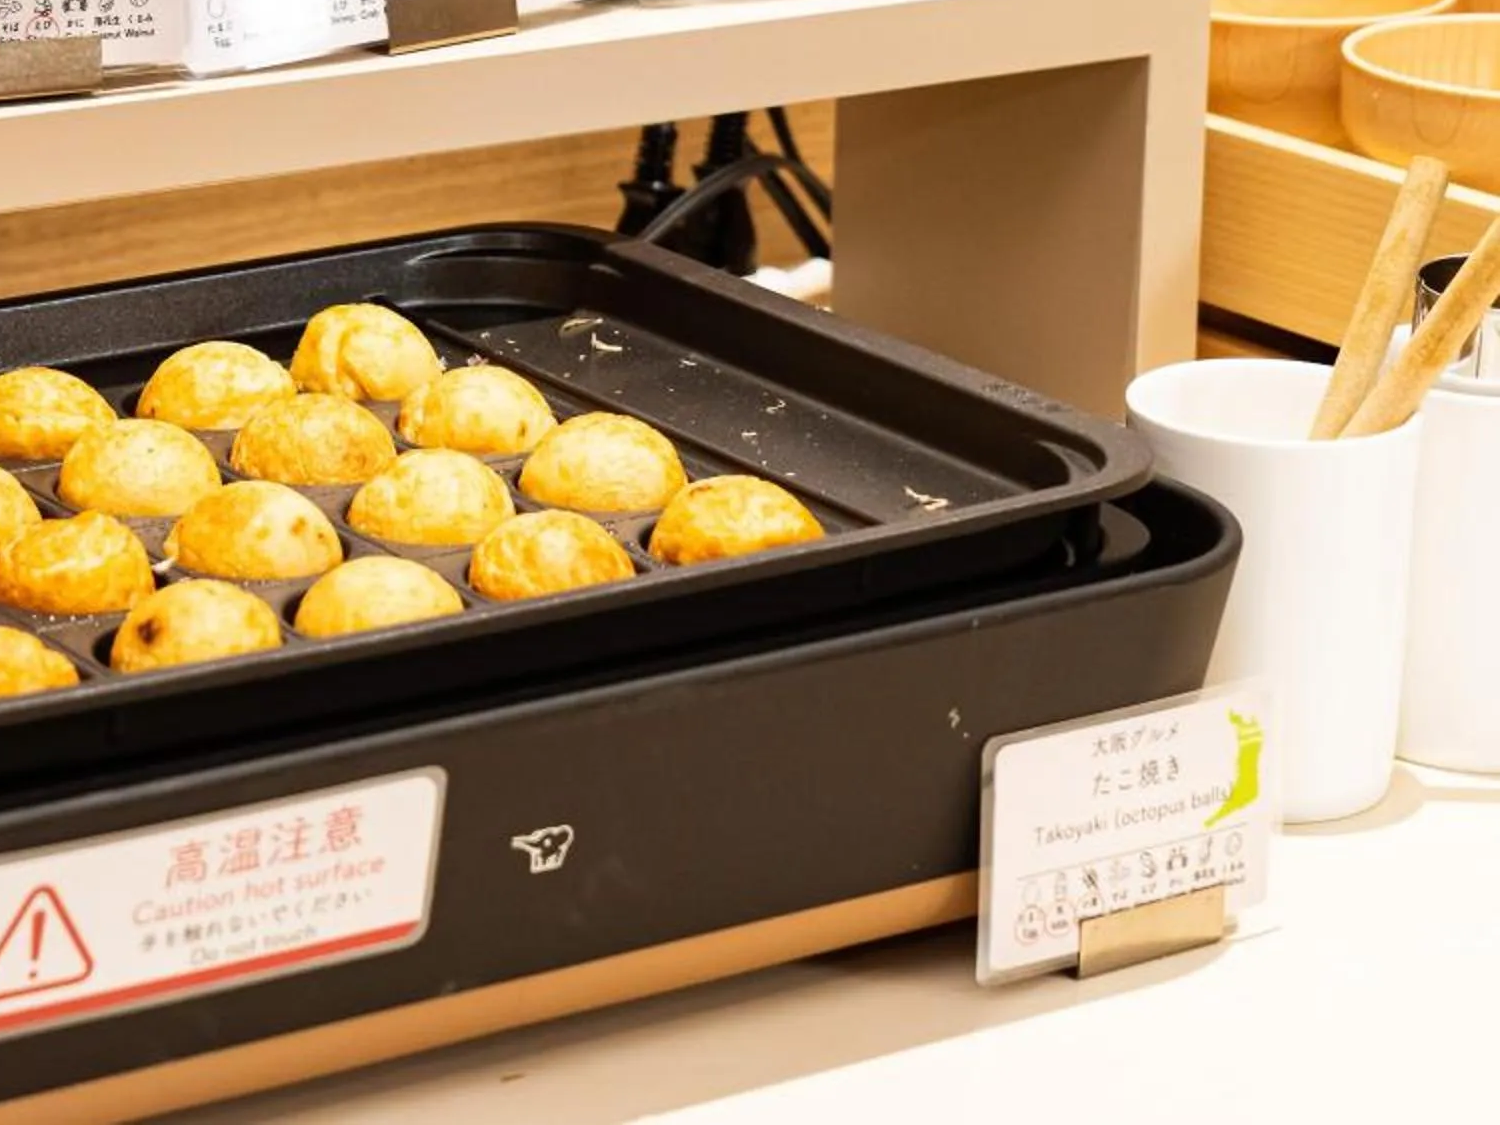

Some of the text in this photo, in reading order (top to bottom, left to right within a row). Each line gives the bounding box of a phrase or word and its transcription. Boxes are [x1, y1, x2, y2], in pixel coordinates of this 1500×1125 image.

[1092, 722, 1181, 758] 大阪グルメ
[1091, 755, 1181, 796] たこ焼き
[164, 804, 363, 889] 高温注意
[1032, 819, 1107, 849] Takoyaki
[1114, 800, 1187, 833] (octopus
[131, 856, 386, 926] Caution hot surface
